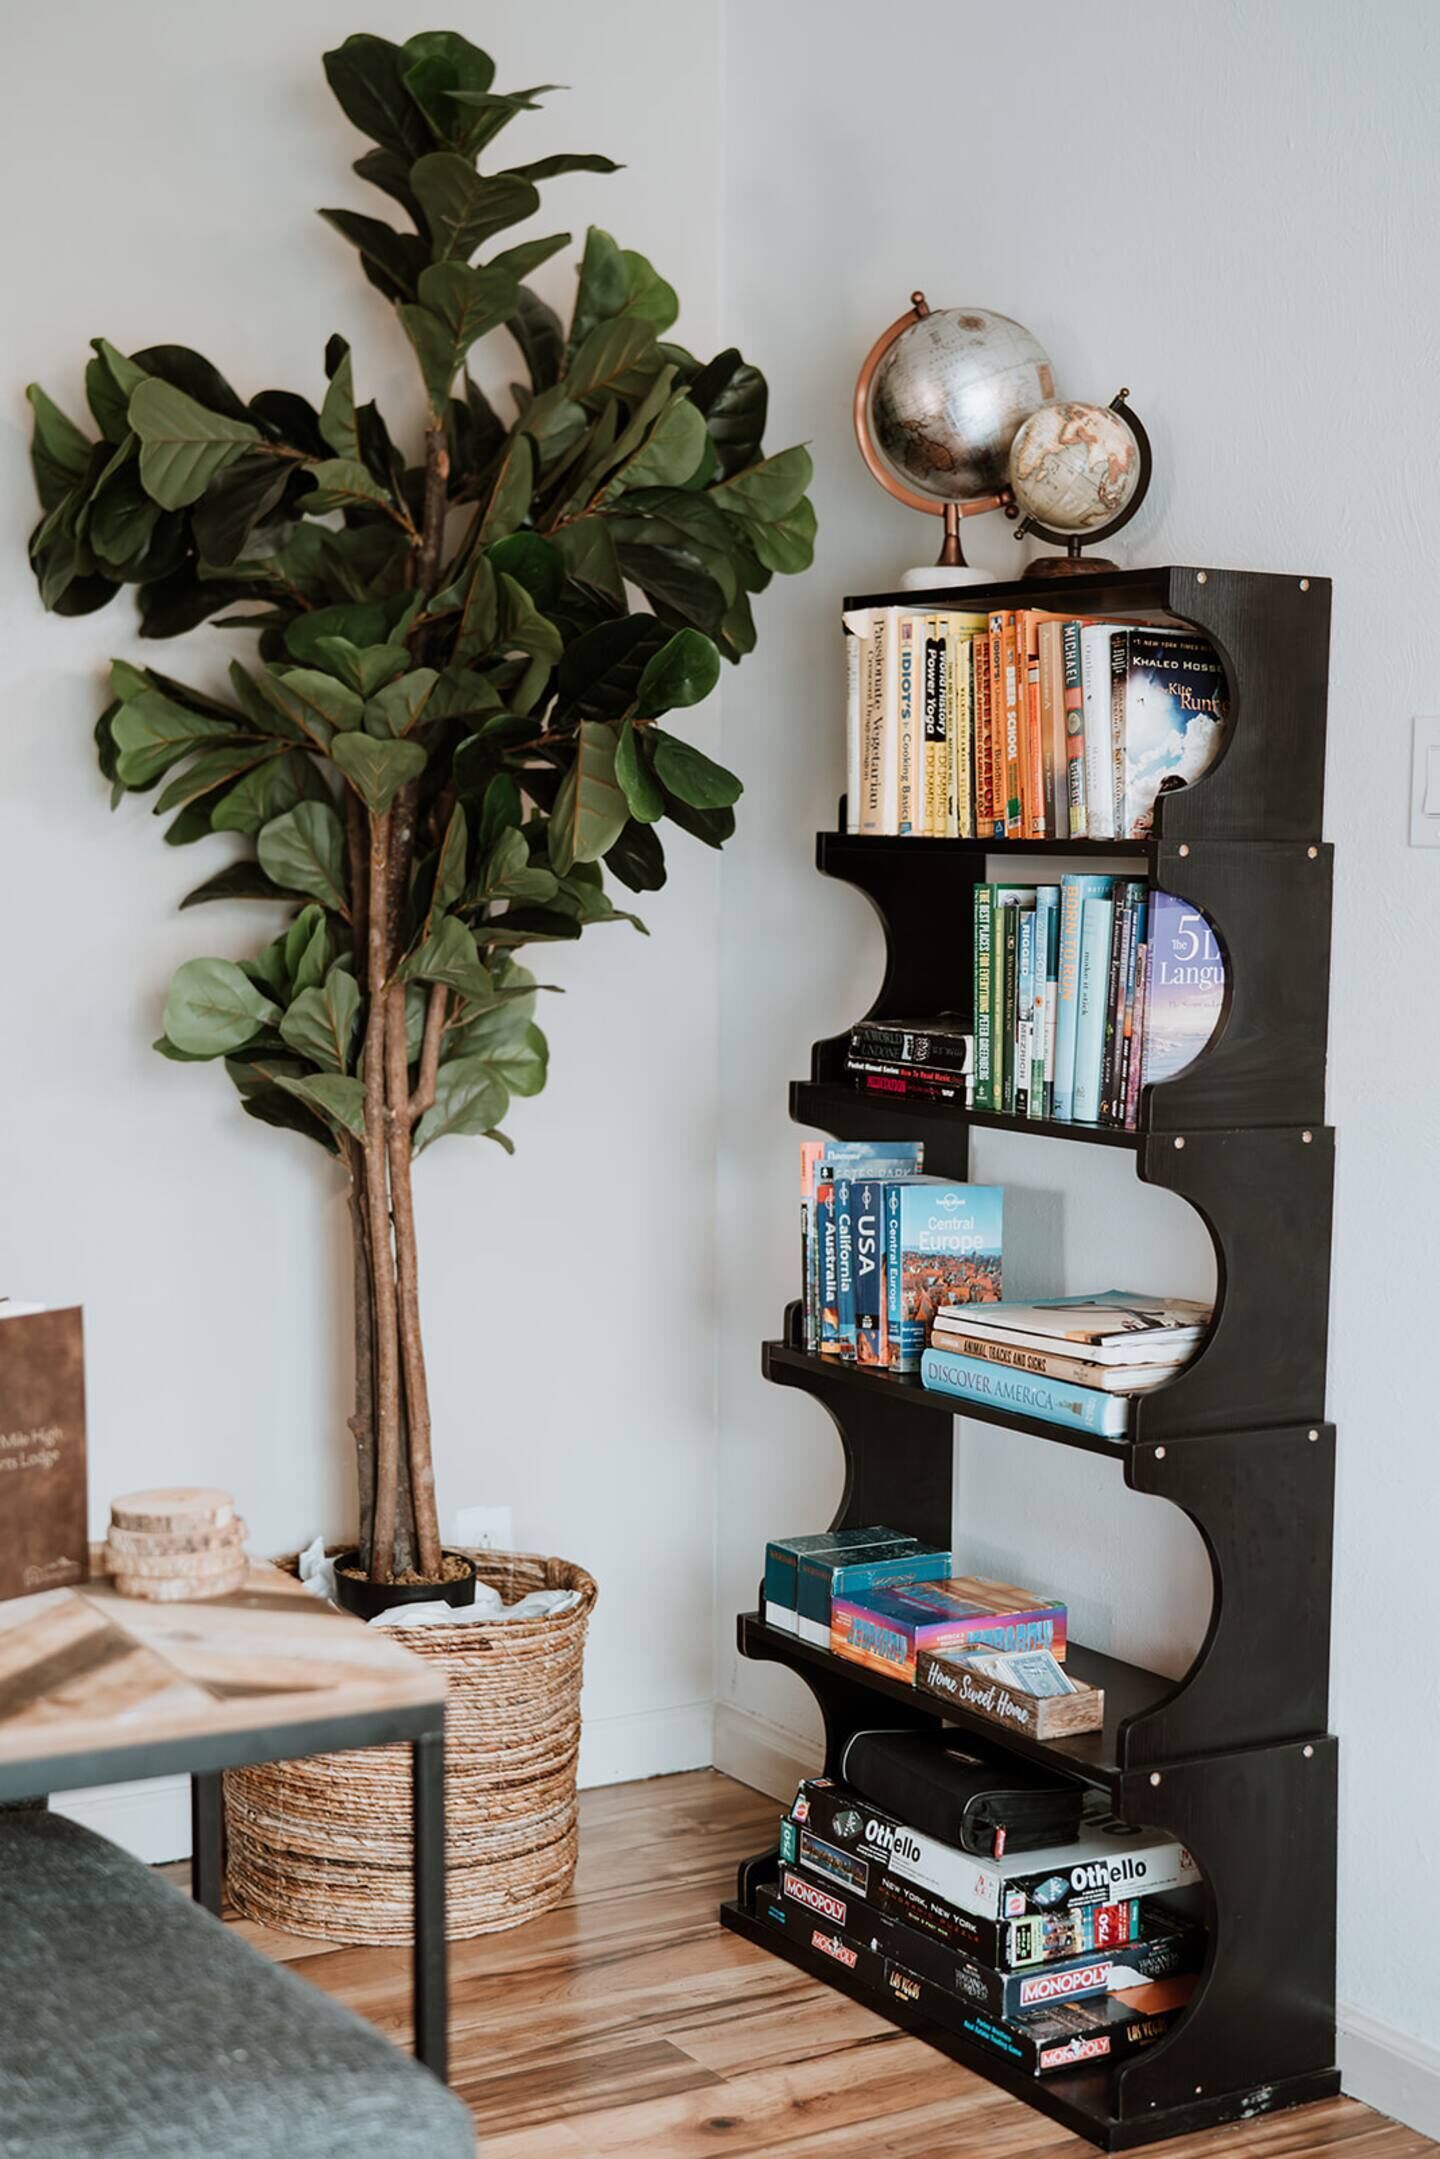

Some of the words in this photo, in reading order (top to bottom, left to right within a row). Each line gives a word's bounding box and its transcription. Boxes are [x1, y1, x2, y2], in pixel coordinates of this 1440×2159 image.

[992, 640, 1001, 681] IDIOT'S
[1063, 626, 1079, 685] MICHAEL
[1132, 657, 1179, 670] KHALED
[1144, 640, 1158, 648] NEW
[1161, 641, 1177, 650] YORK
[1180, 643, 1198, 651] TIMES
[873, 620, 886, 711] Passionate
[926, 648, 937, 695] Power
[938, 650, 947, 687] World
[901, 651, 912, 720] IDIOT'S
[1006, 666, 1017, 707] BEER
[1168, 682, 1193, 698] Kite
[926, 697, 937, 734] Yoga
[937, 689, 947, 735] History
[1007, 711, 1017, 761] SCHOOL
[869, 716, 884, 810] Vegetarian
[900, 733, 911, 782] Cooking
[994, 749, 1003, 804] Buddhism
[901, 785, 911, 820] Basics
[978, 889, 990, 904] THE
[978, 905, 990, 923] BEST
[1065, 886, 1079, 934] BORN
[1114, 899, 1124, 918] The
[978, 924, 990, 951] PLACES
[1021, 924, 1030, 976] RIGGED
[1063, 940, 1077, 961] TO
[1172, 939, 1188, 951] The
[1175, 913, 1203, 961] 5
[978, 953, 990, 968] FOR
[1083, 951, 1091, 980] make
[1160, 961, 1225, 992] Langu
[978, 969, 990, 1013] EVERYTHING
[1061, 964, 1076, 1003] RUN
[1108, 959, 1120, 1007] Experiment
[1081, 992, 1091, 1017] stick
[978, 1014, 990, 1037] PETER
[978, 1038, 990, 1080] GREENBERG
[1018, 1023, 1027, 1079] MEZRICH
[900, 1069, 911, 1077] How
[913, 1070, 919, 1079] To
[920, 1071, 933, 1081] Read
[935, 1073, 951, 1083] Music
[879, 1167, 912, 1177] PARK
[928, 1215, 975, 1231] Central
[839, 1213, 852, 1293] California
[857, 1215, 876, 1277] USA
[888, 1219, 898, 1266] Central
[919, 1230, 985, 1255] Europe
[825, 1221, 837, 1303] Australia
[888, 1268, 897, 1313] Europe
[963, 1340, 989, 1359] ANIMAL
[989, 1346, 1013, 1365] TRACKS
[1013, 1351, 1027, 1367] AND
[1027, 1354, 1048, 1372] SIGNS
[928, 1362, 993, 1396] DISCOVER
[31, 1426, 64, 1449] High
[19, 1448, 61, 1470] Lodge
[926, 1661, 957, 1693] Home
[959, 1674, 997, 1711] Sweet
[996, 1690, 1030, 1724] Home
[864, 1819, 921, 1864] Othello
[1070, 1858, 1147, 1892] Othello
[786, 1877, 845, 1921] MONOPOLY
[882, 1878, 901, 1893] NEW
[903, 1888, 928, 1910] YORK,
[930, 1903, 950, 1920] NEW
[952, 1914, 978, 1934] YORK
[1098, 1913, 1110, 1942] 750
[812, 1931, 859, 1968] MONPOLY
[889, 1970, 901, 1990] LAS
[901, 1974, 921, 2000] VEGAS
[1022, 1963, 1110, 2003] MONOPOLY
[1042, 2038, 1110, 2068] MONPOLY
[1126, 2026, 1142, 2043] LAS
